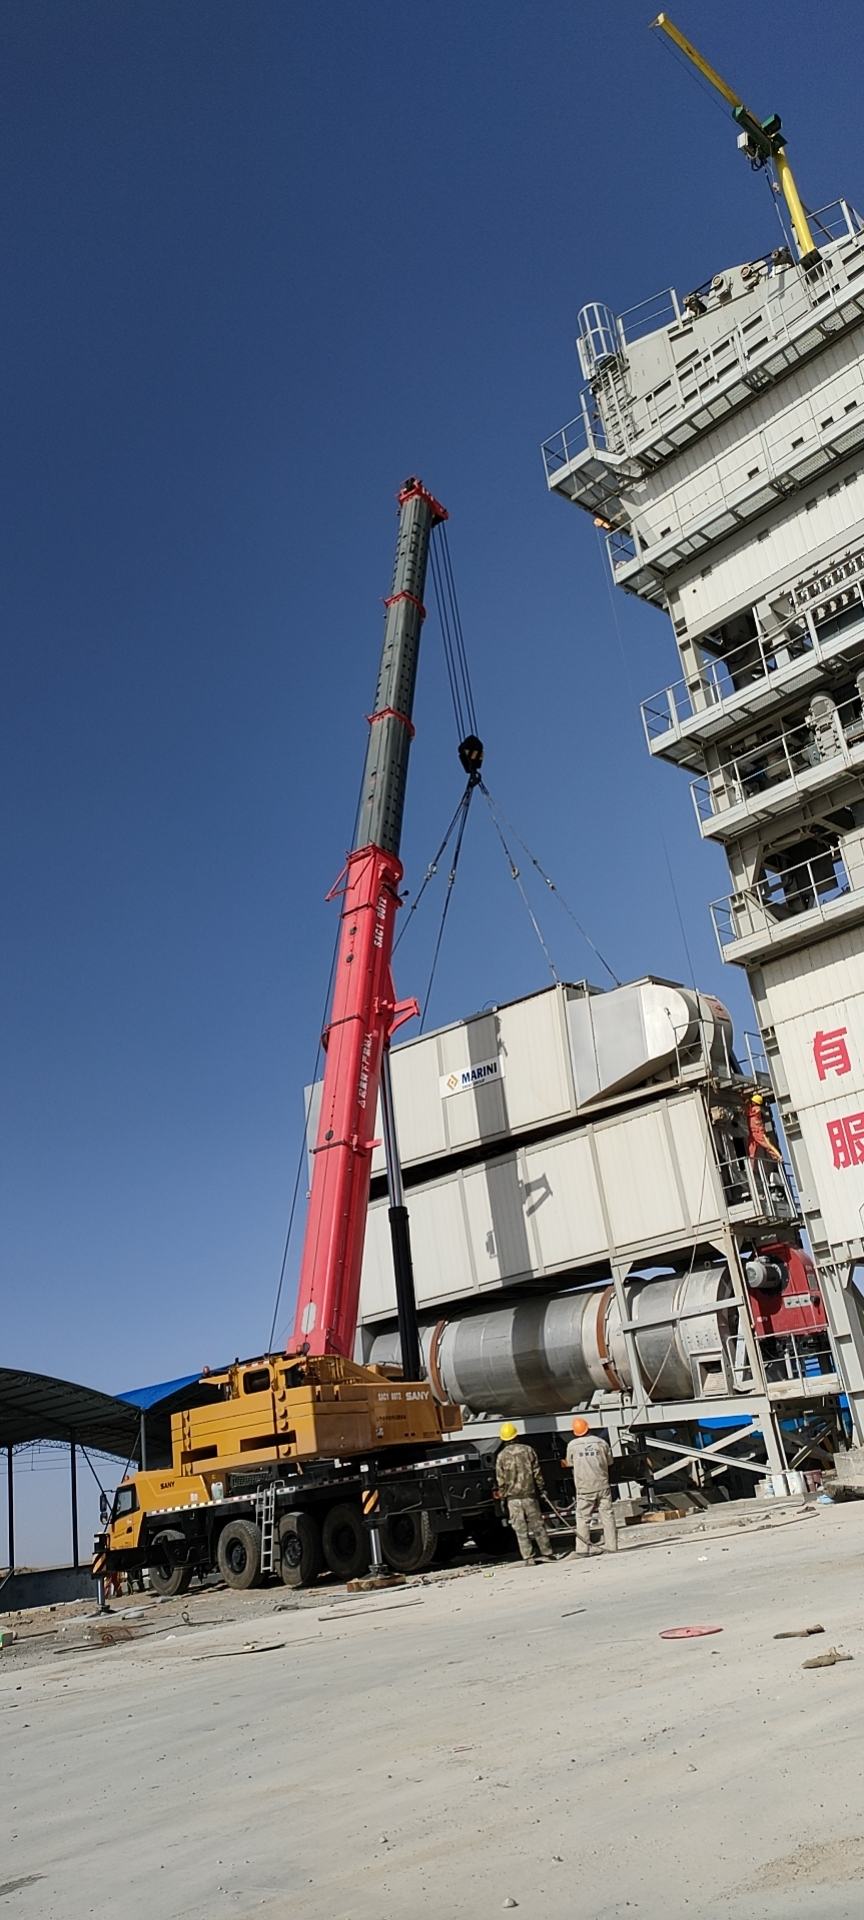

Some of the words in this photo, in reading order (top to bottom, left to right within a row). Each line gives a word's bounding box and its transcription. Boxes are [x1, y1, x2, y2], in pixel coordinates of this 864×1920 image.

[813, 1027, 851, 1081] 有
[461, 1062, 497, 1084] MARINI
[826, 1112, 864, 1169] 服
[405, 1391, 430, 1400] SANY
[160, 1481, 175, 1490] SANY
